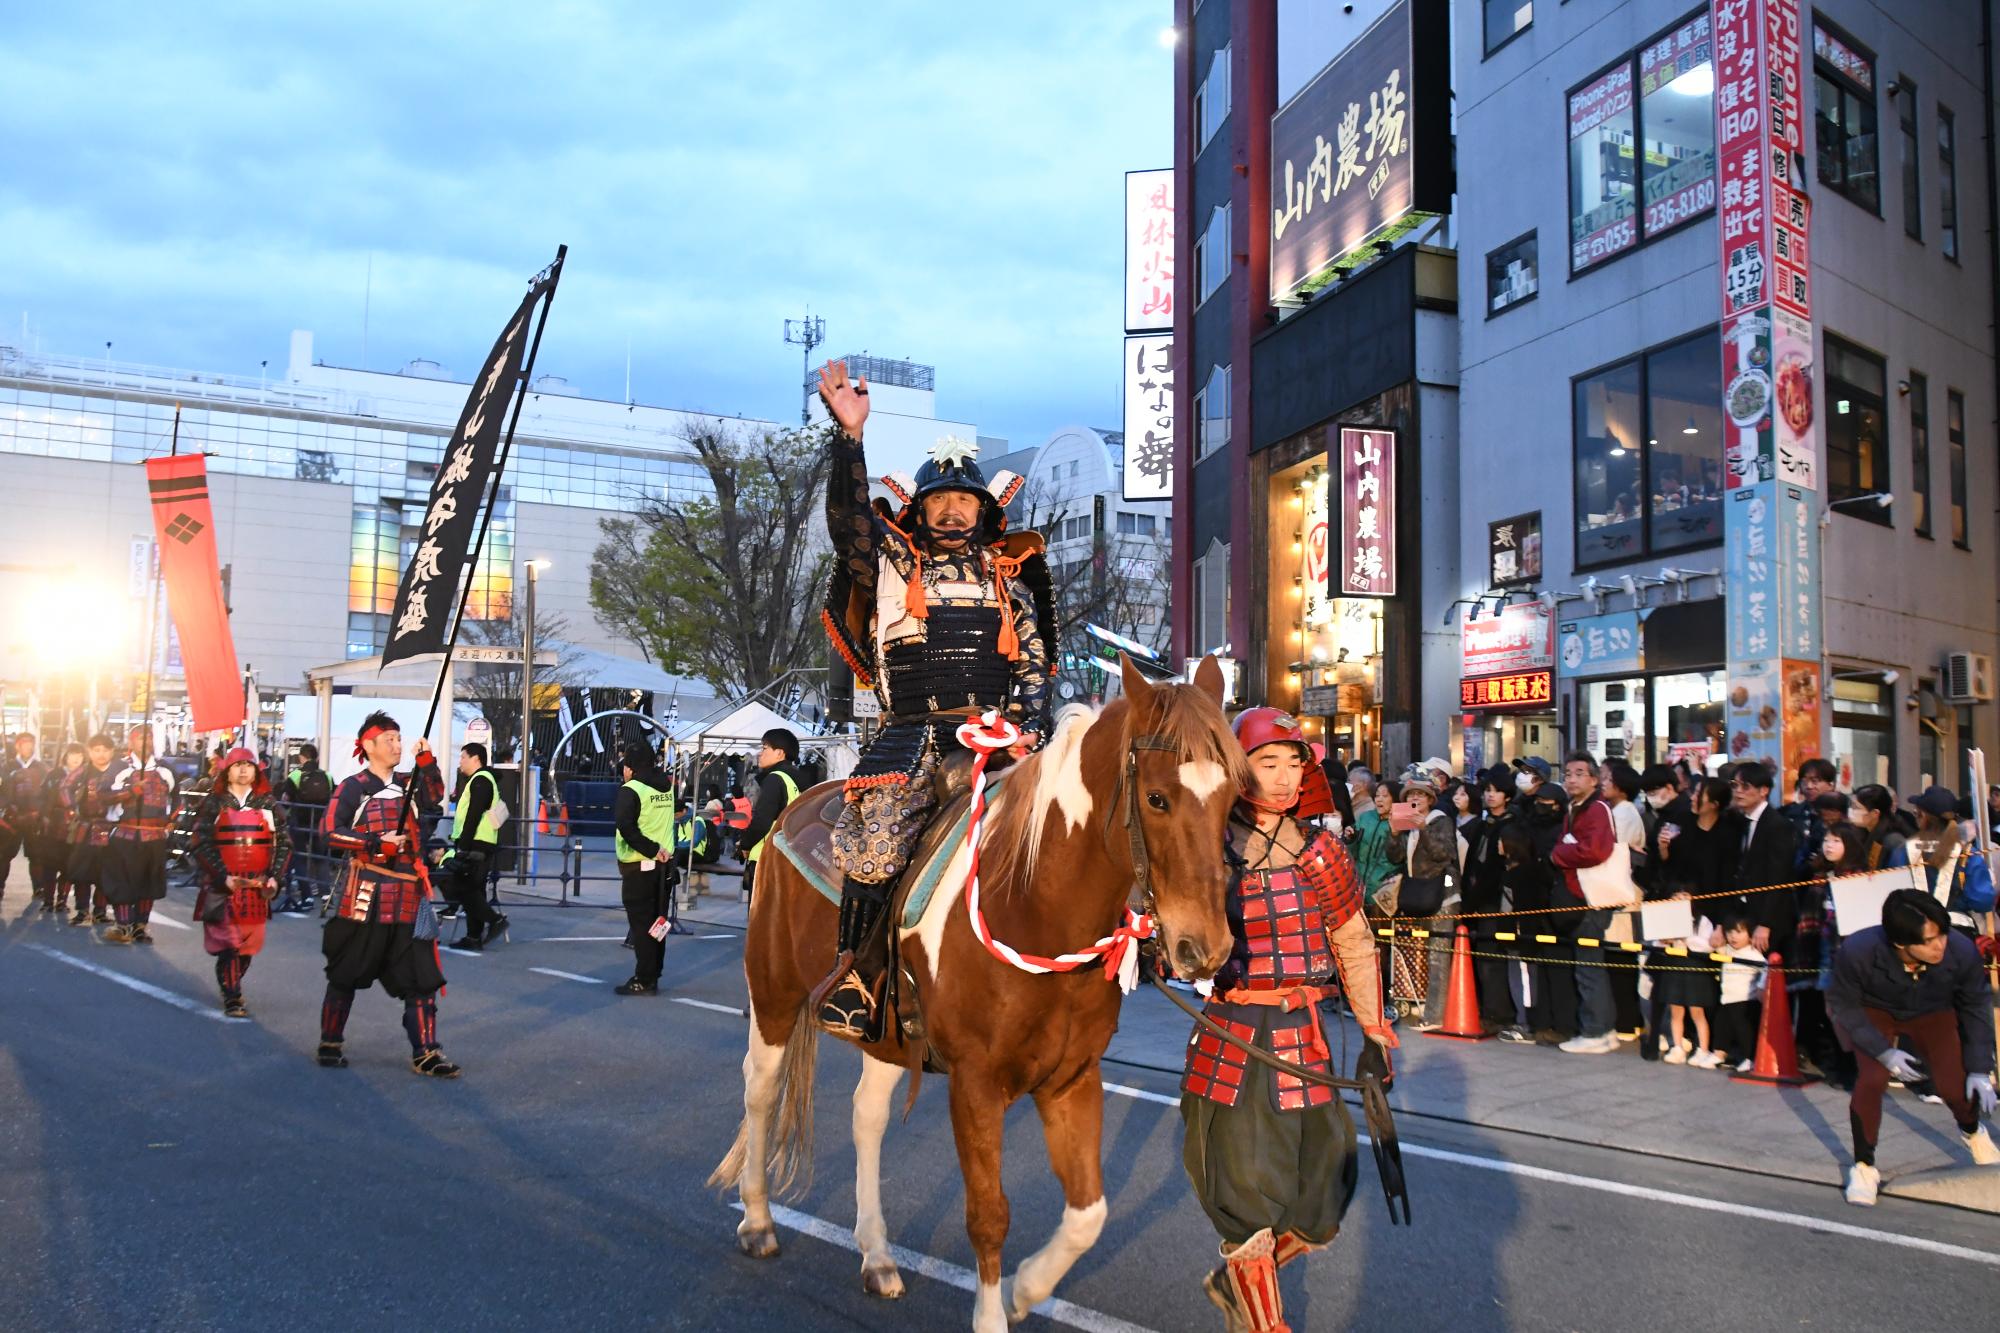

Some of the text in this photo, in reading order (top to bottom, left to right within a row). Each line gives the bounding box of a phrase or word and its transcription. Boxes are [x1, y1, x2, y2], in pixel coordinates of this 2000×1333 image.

[1275, 69, 1405, 240] 山内農場
[1354, 434, 1383, 579] 山内農場
[460, 649, 537, 661] 送迎バス乗降
[650, 793, 673, 804] PRESS
